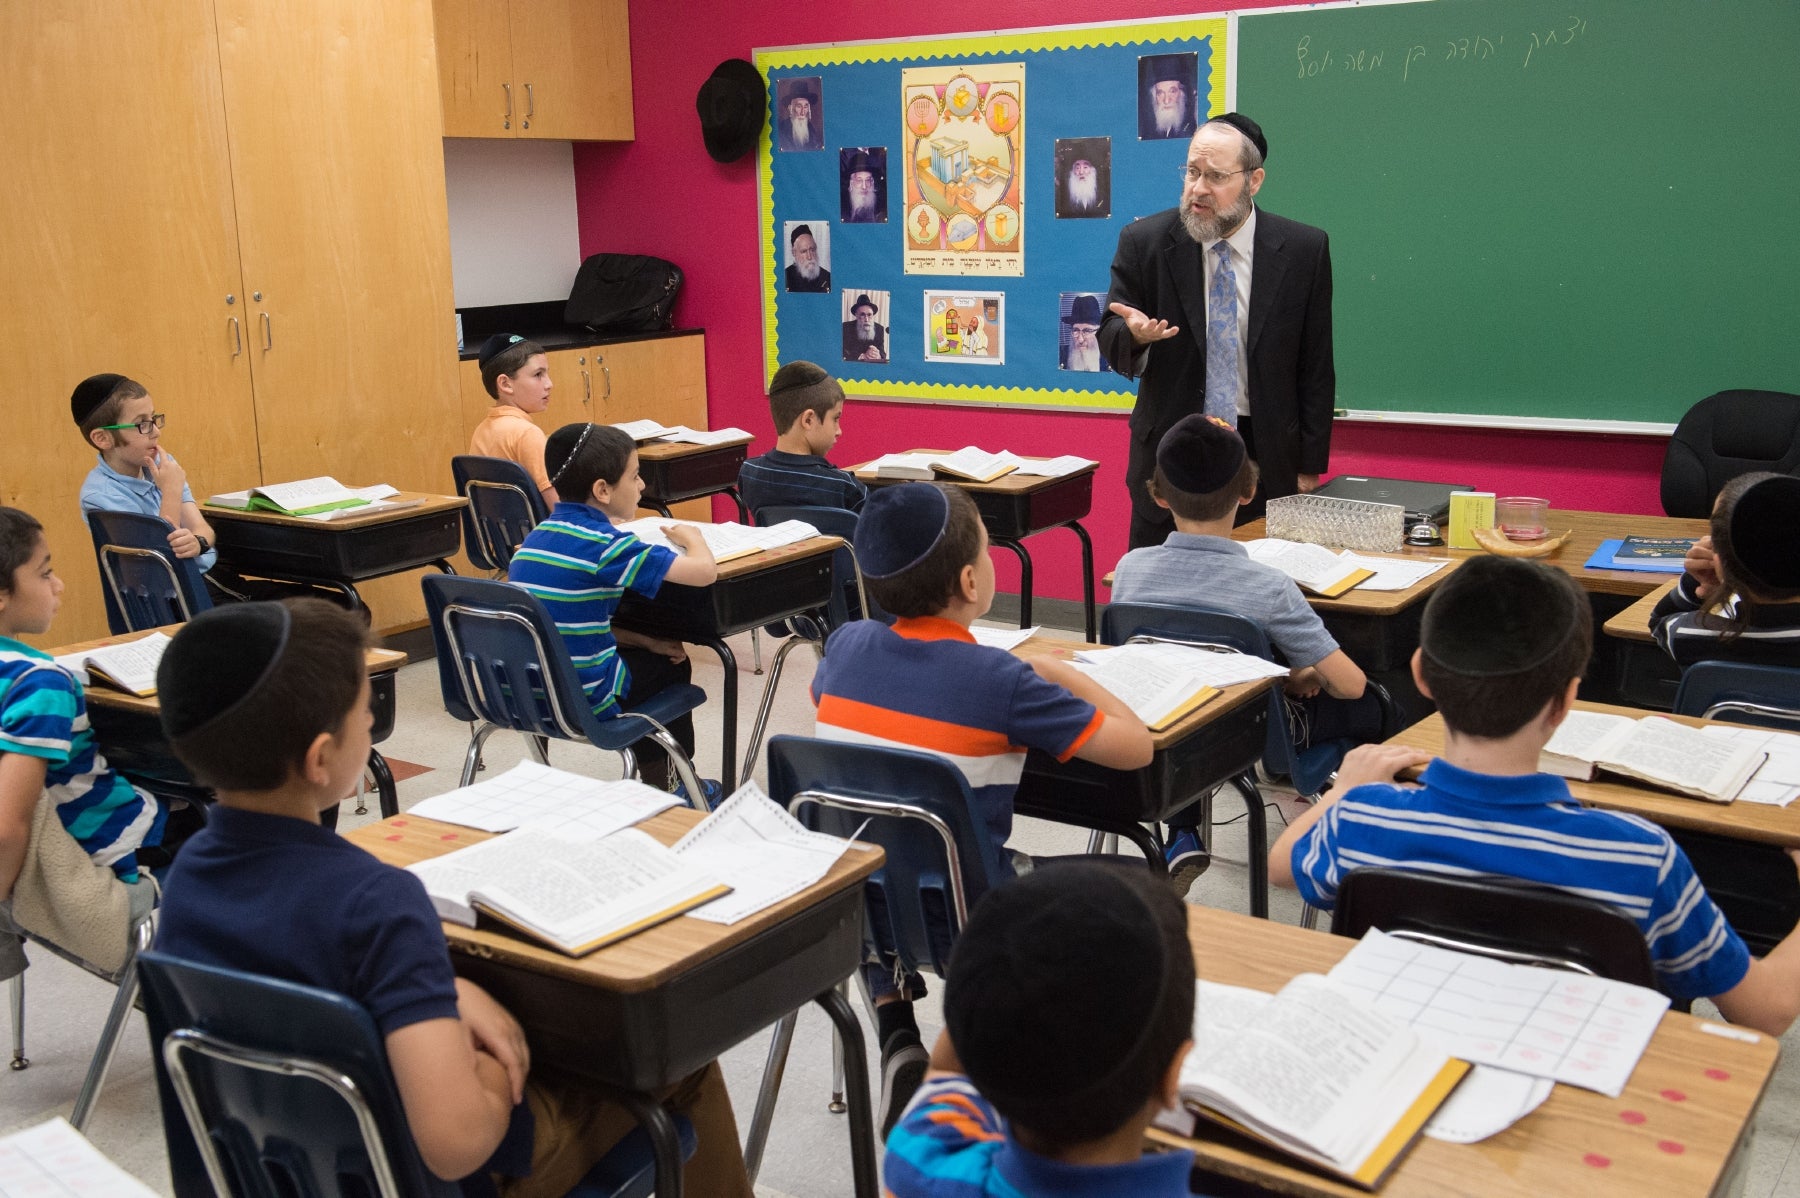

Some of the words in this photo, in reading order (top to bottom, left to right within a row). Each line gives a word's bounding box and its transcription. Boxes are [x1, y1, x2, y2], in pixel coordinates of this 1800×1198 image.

[1297, 34, 1334, 79] יוסף
[1343, 48, 1385, 72] משה
[1445, 34, 1504, 61] יהודה
[1403, 45, 1427, 83] בן
